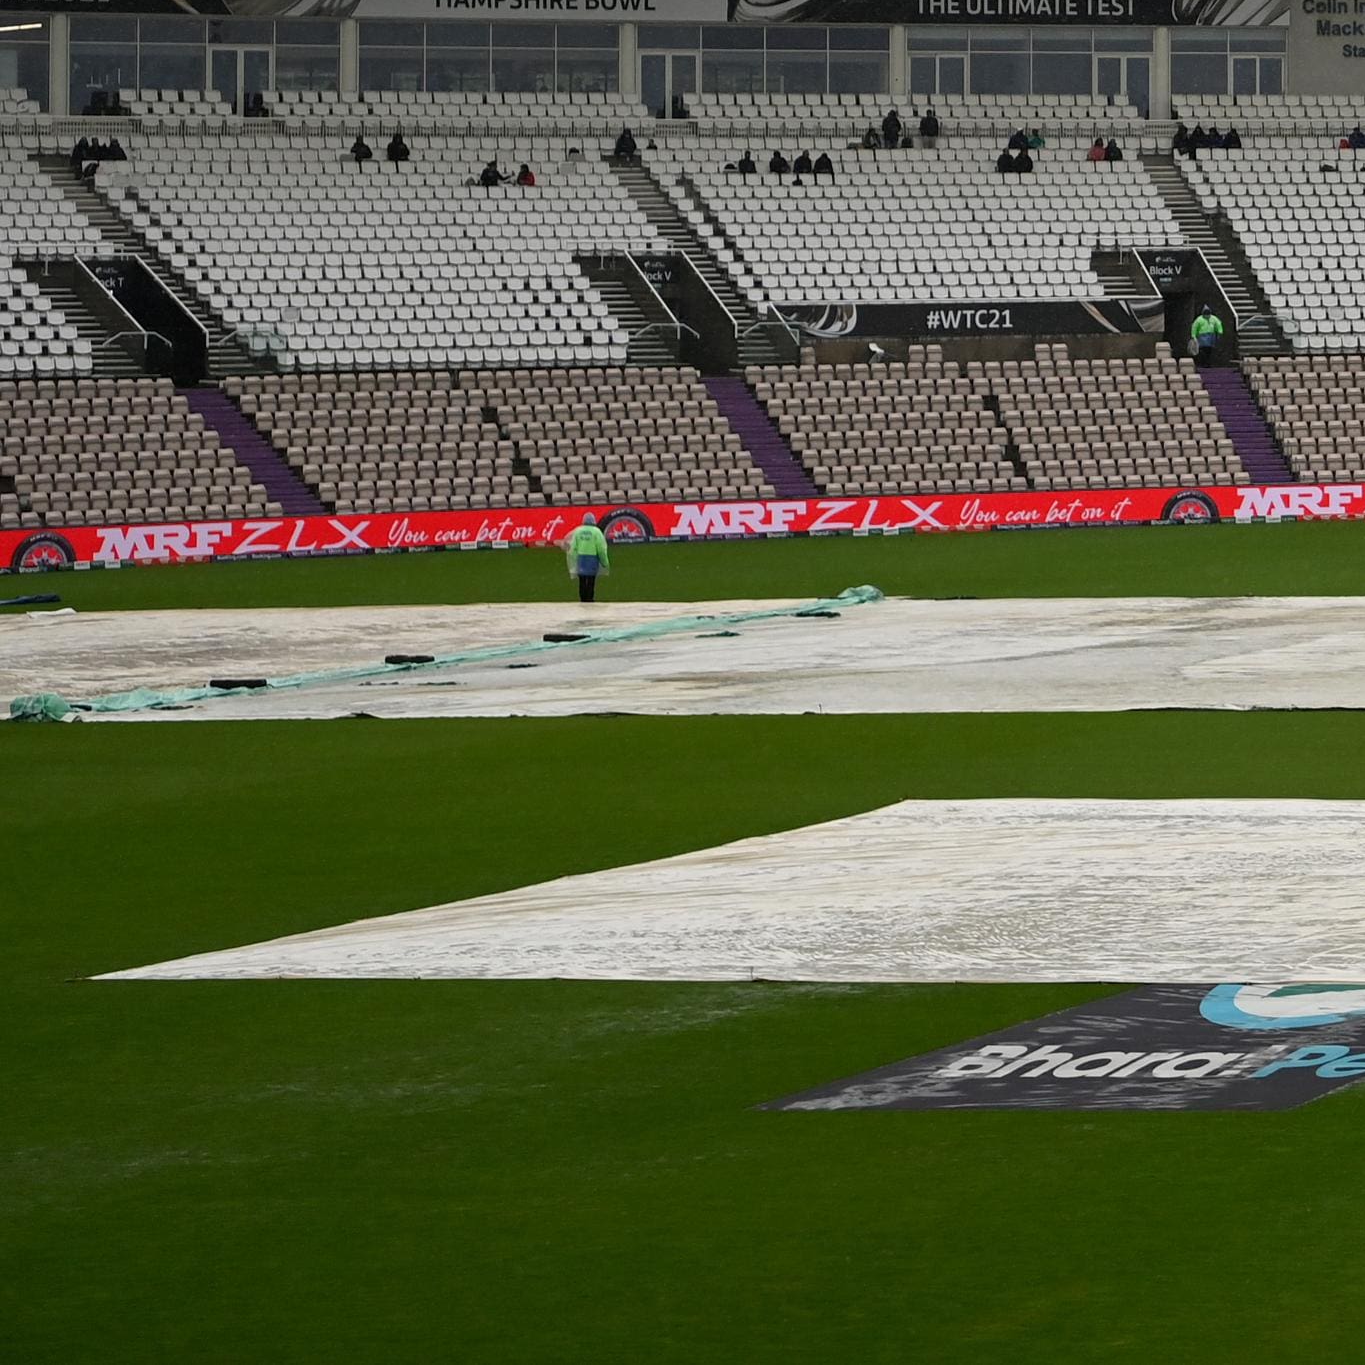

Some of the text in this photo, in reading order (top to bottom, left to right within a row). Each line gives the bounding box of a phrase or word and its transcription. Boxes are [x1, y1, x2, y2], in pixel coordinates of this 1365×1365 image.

[665, 271, 672, 281] V
[1149, 266, 1182, 275] Block V
[118, 277, 124, 287] T
[927, 309, 1013, 329] #WTC21
[1234, 485, 1363, 517] MRF
[670, 501, 807, 534] MRF
[958, 499, 1000, 526] You
[1005, 509, 1040, 523] can
[1045, 498, 1083, 524] bet
[1081, 508, 1106, 521] on
[1110, 496, 1131, 522] it
[93, 521, 232, 561] MRF
[387, 517, 430, 546] You
[435, 527, 469, 543] can
[474, 518, 513, 543] bet
[511, 526, 537, 539] on
[540, 515, 563, 540] it
